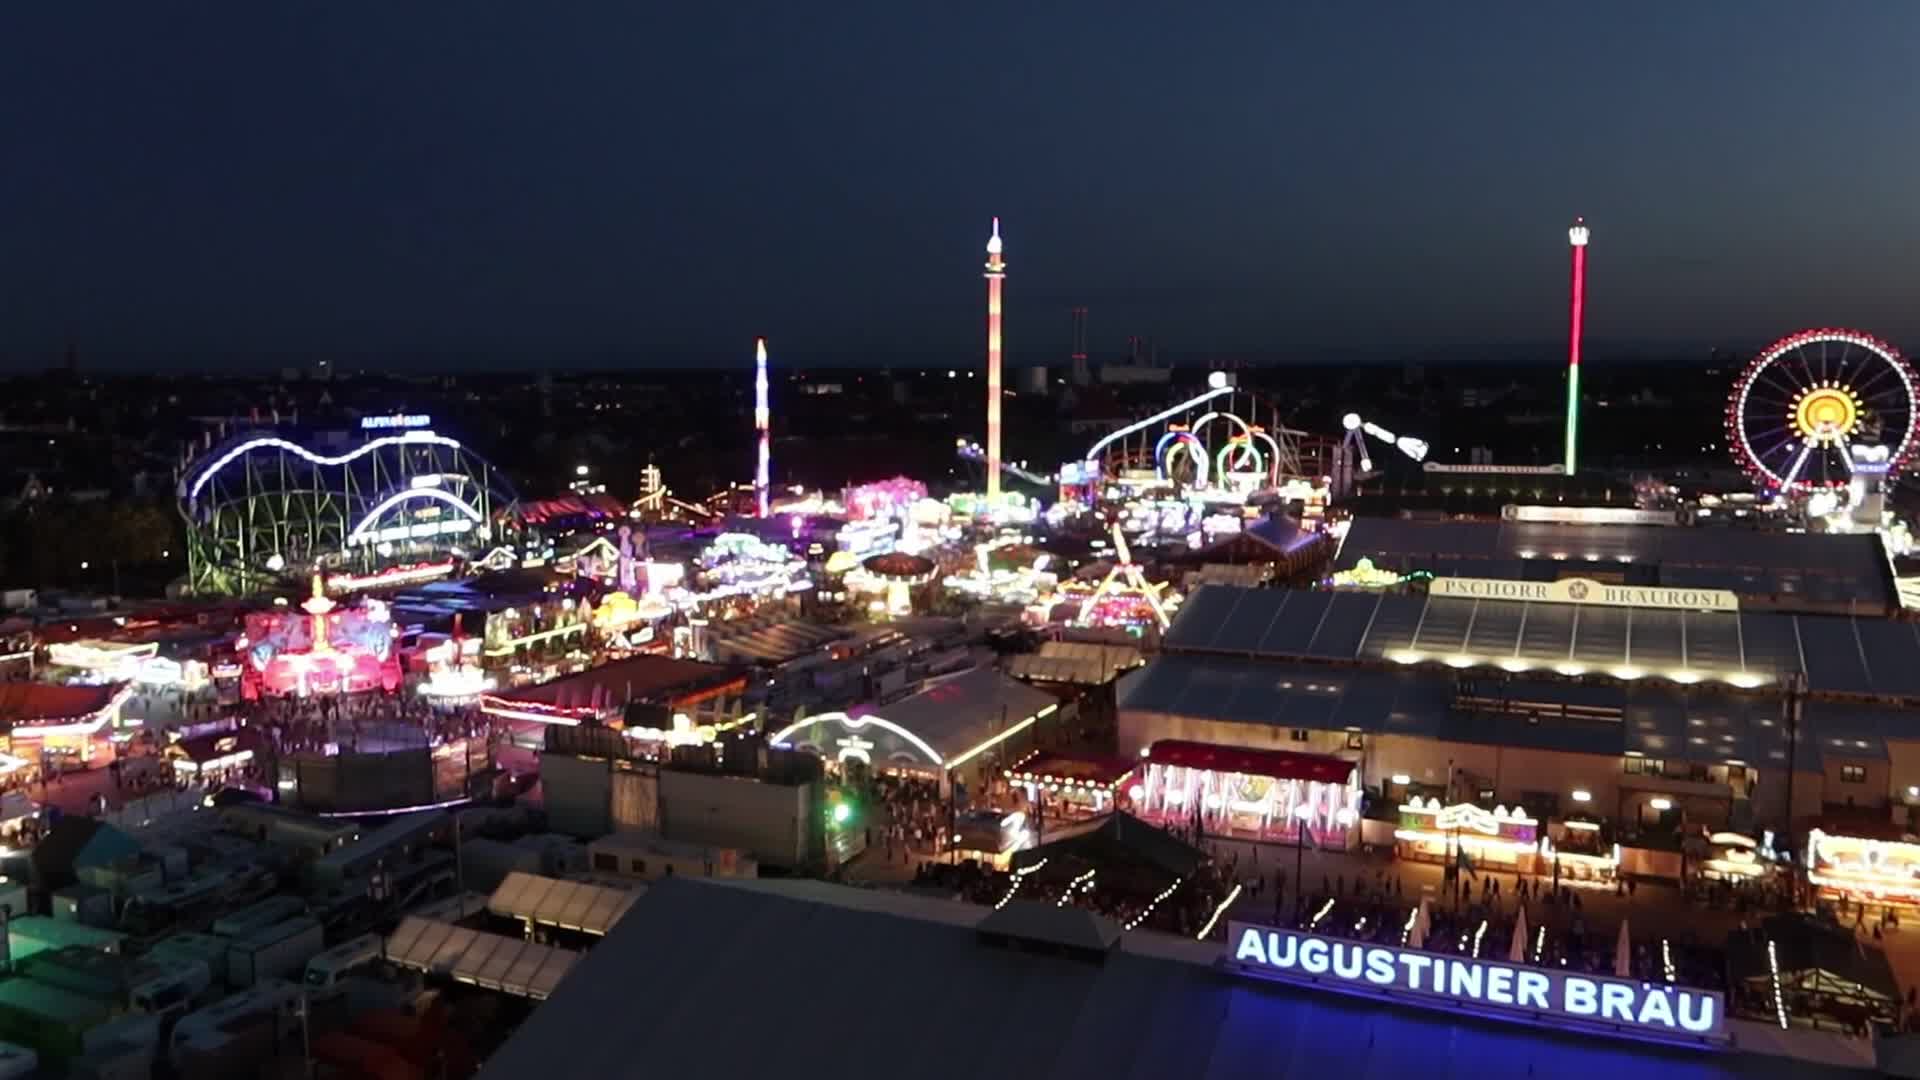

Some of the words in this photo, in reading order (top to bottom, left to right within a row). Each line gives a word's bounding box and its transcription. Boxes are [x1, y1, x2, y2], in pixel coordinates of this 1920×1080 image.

[1444, 580, 1547, 598] PSCHORR
[1236, 928, 1550, 1009] AUGUSTINER
[1564, 977, 1714, 1032] BRÄU
